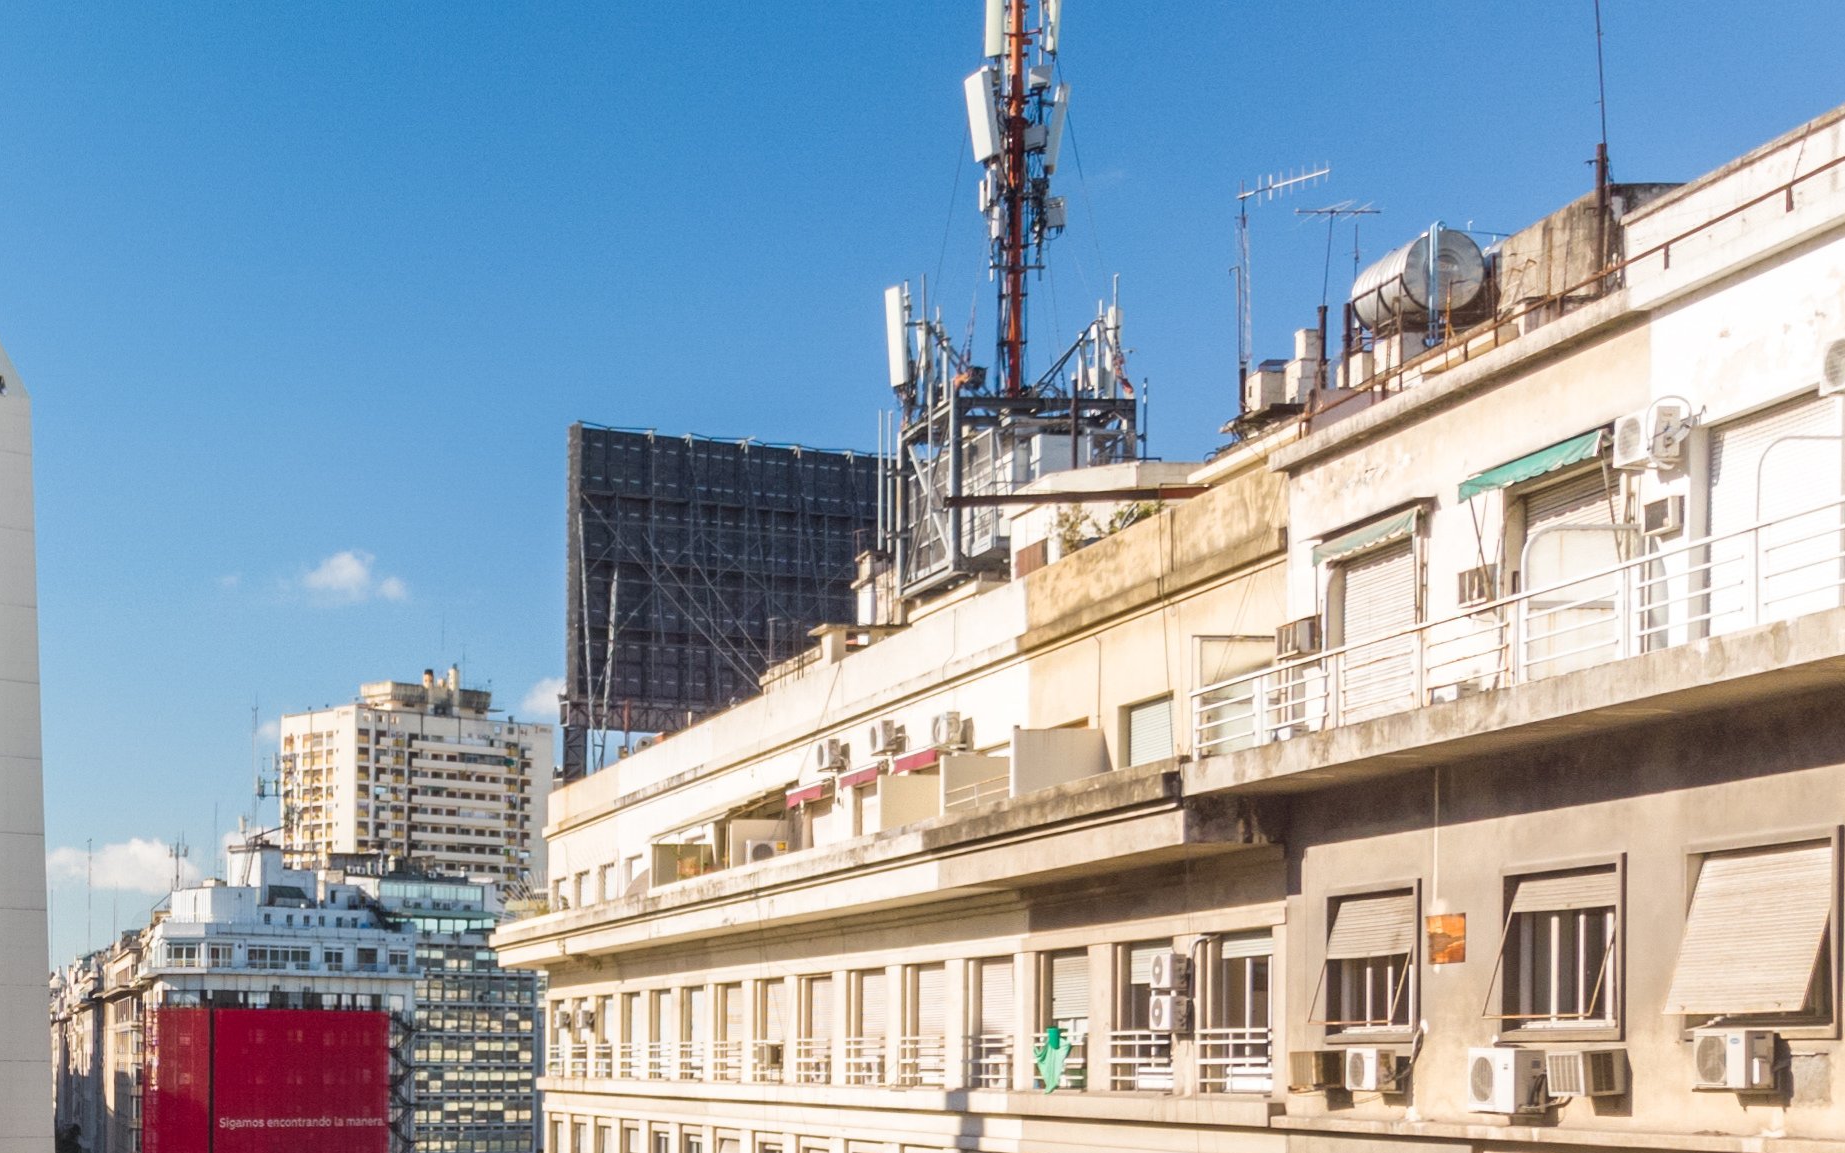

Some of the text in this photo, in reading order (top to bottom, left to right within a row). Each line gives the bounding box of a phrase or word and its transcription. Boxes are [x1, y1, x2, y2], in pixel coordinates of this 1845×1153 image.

[219, 1116, 386, 1130] Sigamos encontrando la manera.
